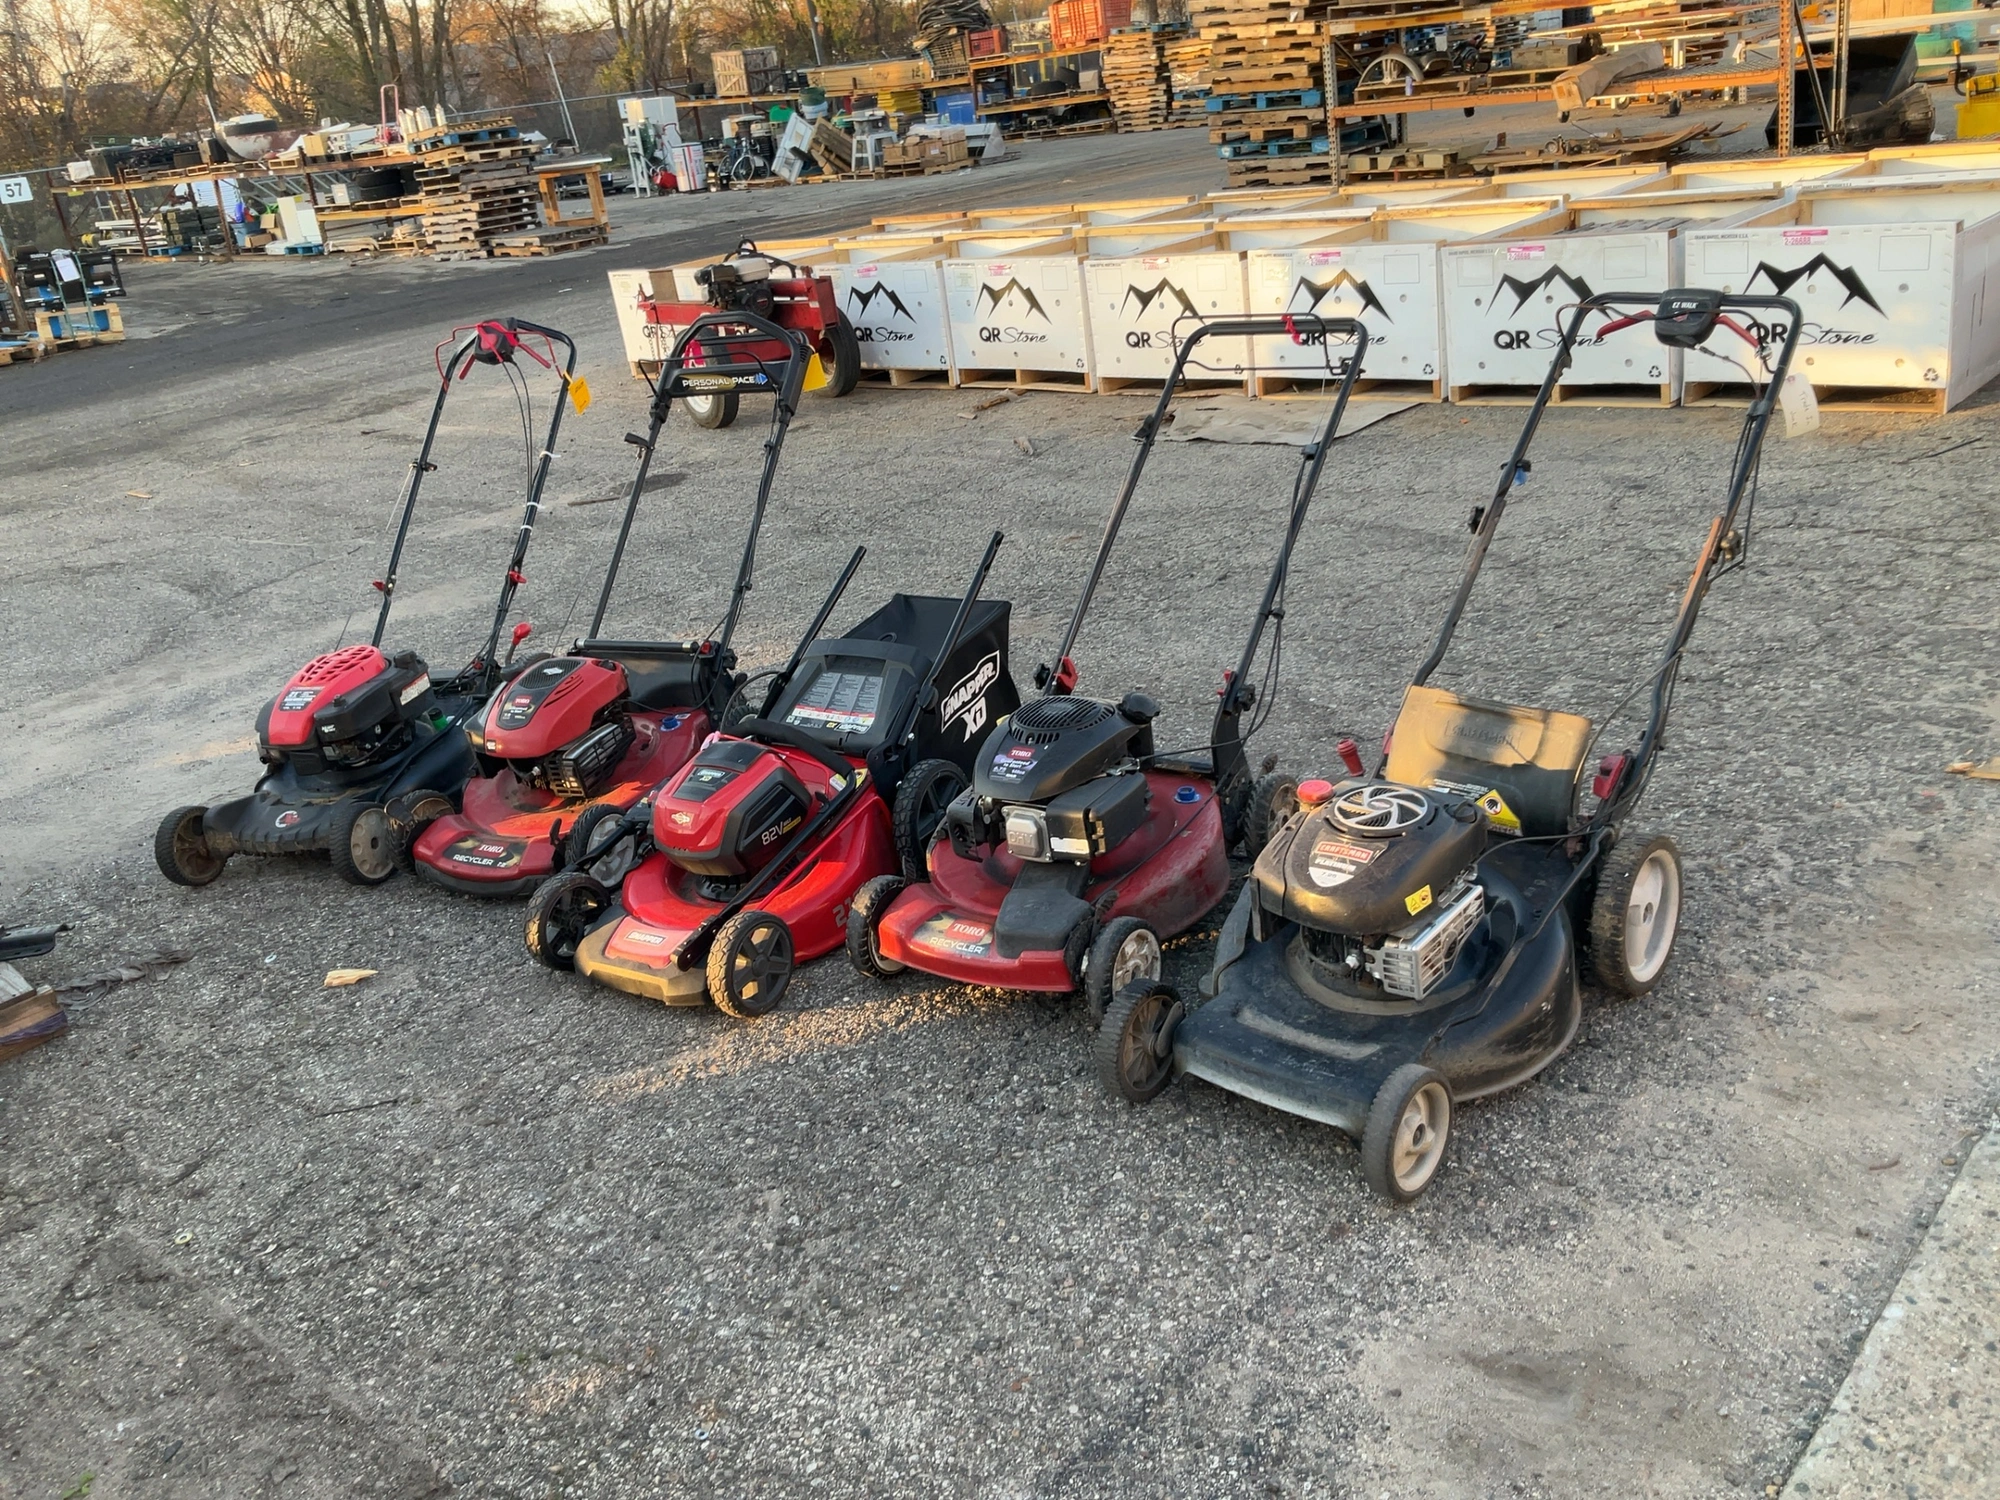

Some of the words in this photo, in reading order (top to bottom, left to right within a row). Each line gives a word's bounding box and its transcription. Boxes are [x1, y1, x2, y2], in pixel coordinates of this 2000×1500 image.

[5, 183, 22, 197] 57
[1672, 301, 1681, 309] EZ
[1681, 301, 1698, 309] WALK
[854, 326, 875, 342] QR
[875, 326, 916, 343] Stone
[979, 326, 1002, 343] QR
[1003, 326, 1048, 343] Stone
[1125, 331, 1152, 348] QR
[1153, 331, 1204, 349] Stoe
[1494, 330, 1531, 350] QR
[1798, 322, 1879, 345] Stone
[682, 378, 729, 387] PERSONAL
[732, 376, 755, 384] PACE
[944, 661, 996, 722] SNAPPER
[961, 696, 987, 743] XD
[761, 821, 784, 845] 82V
[478, 844, 504, 853] TORO
[1319, 844, 1369, 860] CRAFTSMAN
[452, 854, 494, 866] RECYCLER
[952, 923, 986, 937] TORO
[929, 937, 985, 954] RECYCLER
